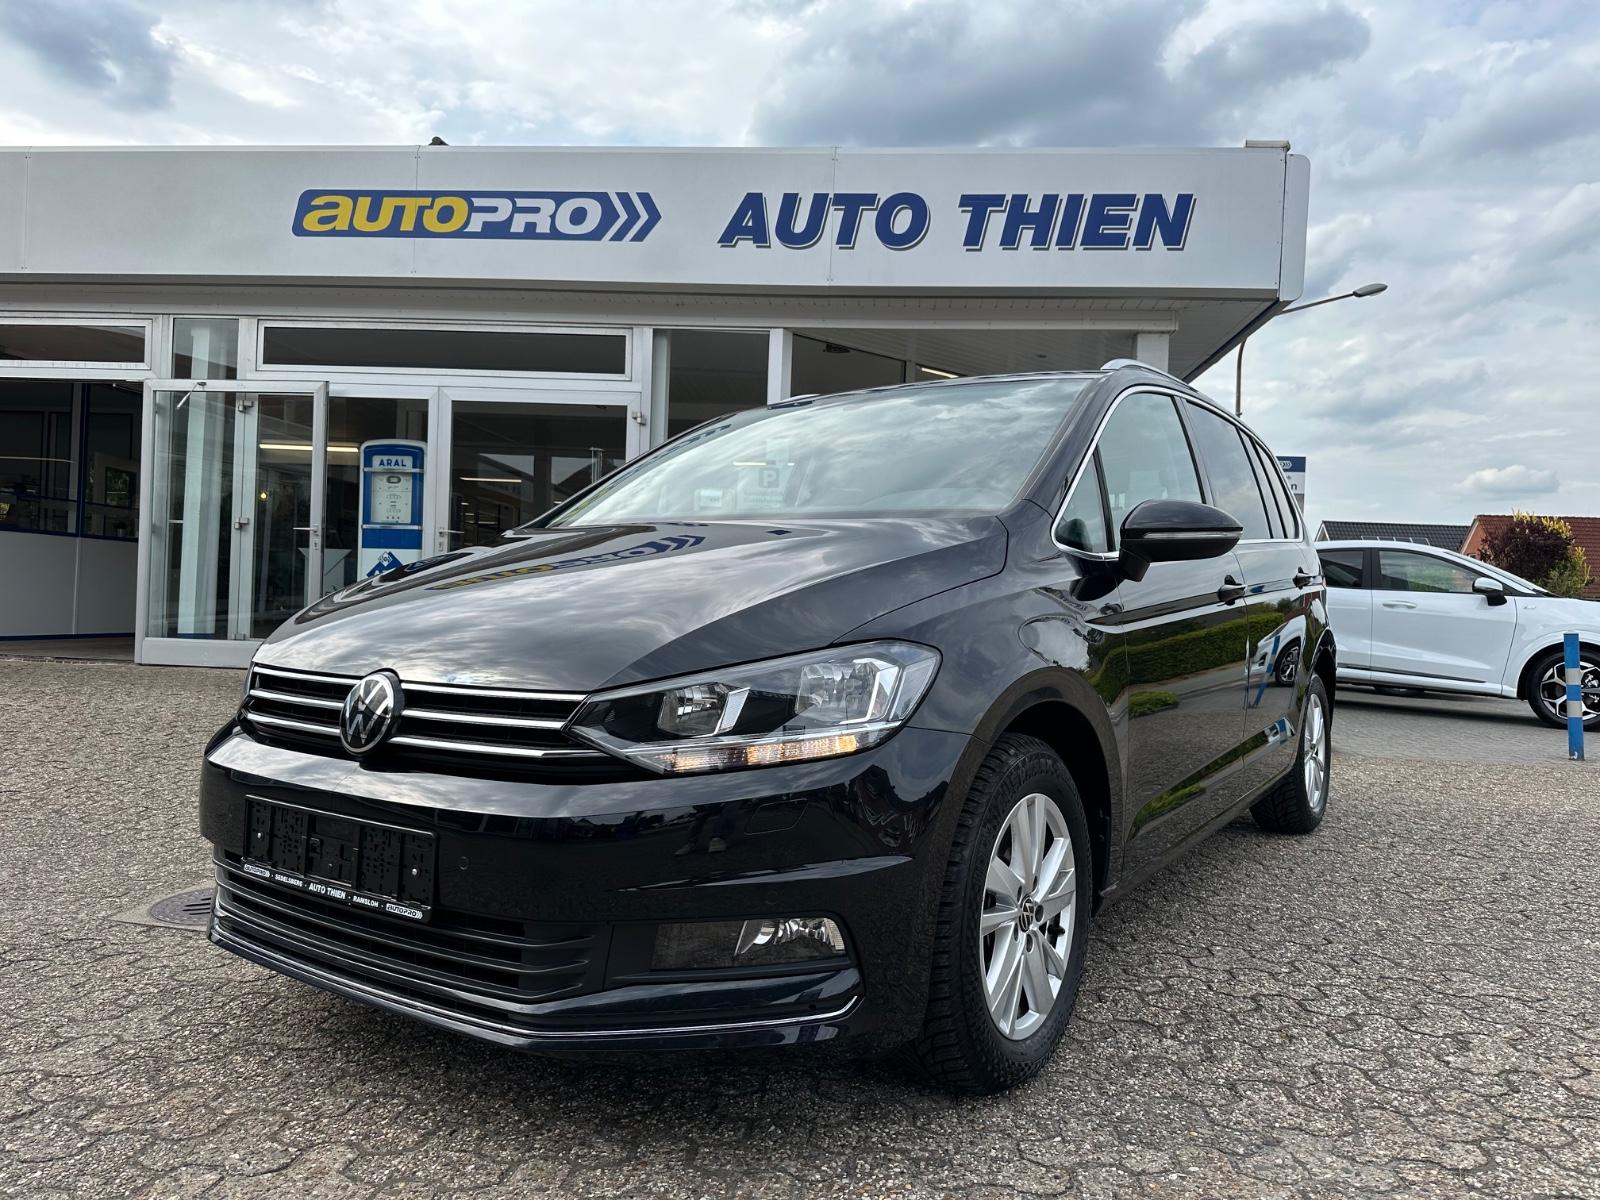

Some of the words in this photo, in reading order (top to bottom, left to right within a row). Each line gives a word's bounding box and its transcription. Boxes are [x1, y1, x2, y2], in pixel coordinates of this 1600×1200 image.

[717, 191, 931, 249] AUTO
[957, 193, 1197, 251] THIEN
[378, 458, 407, 467] ARAL
[308, 882, 326, 894] AUTO
[327, 887, 346, 900] THIEN
